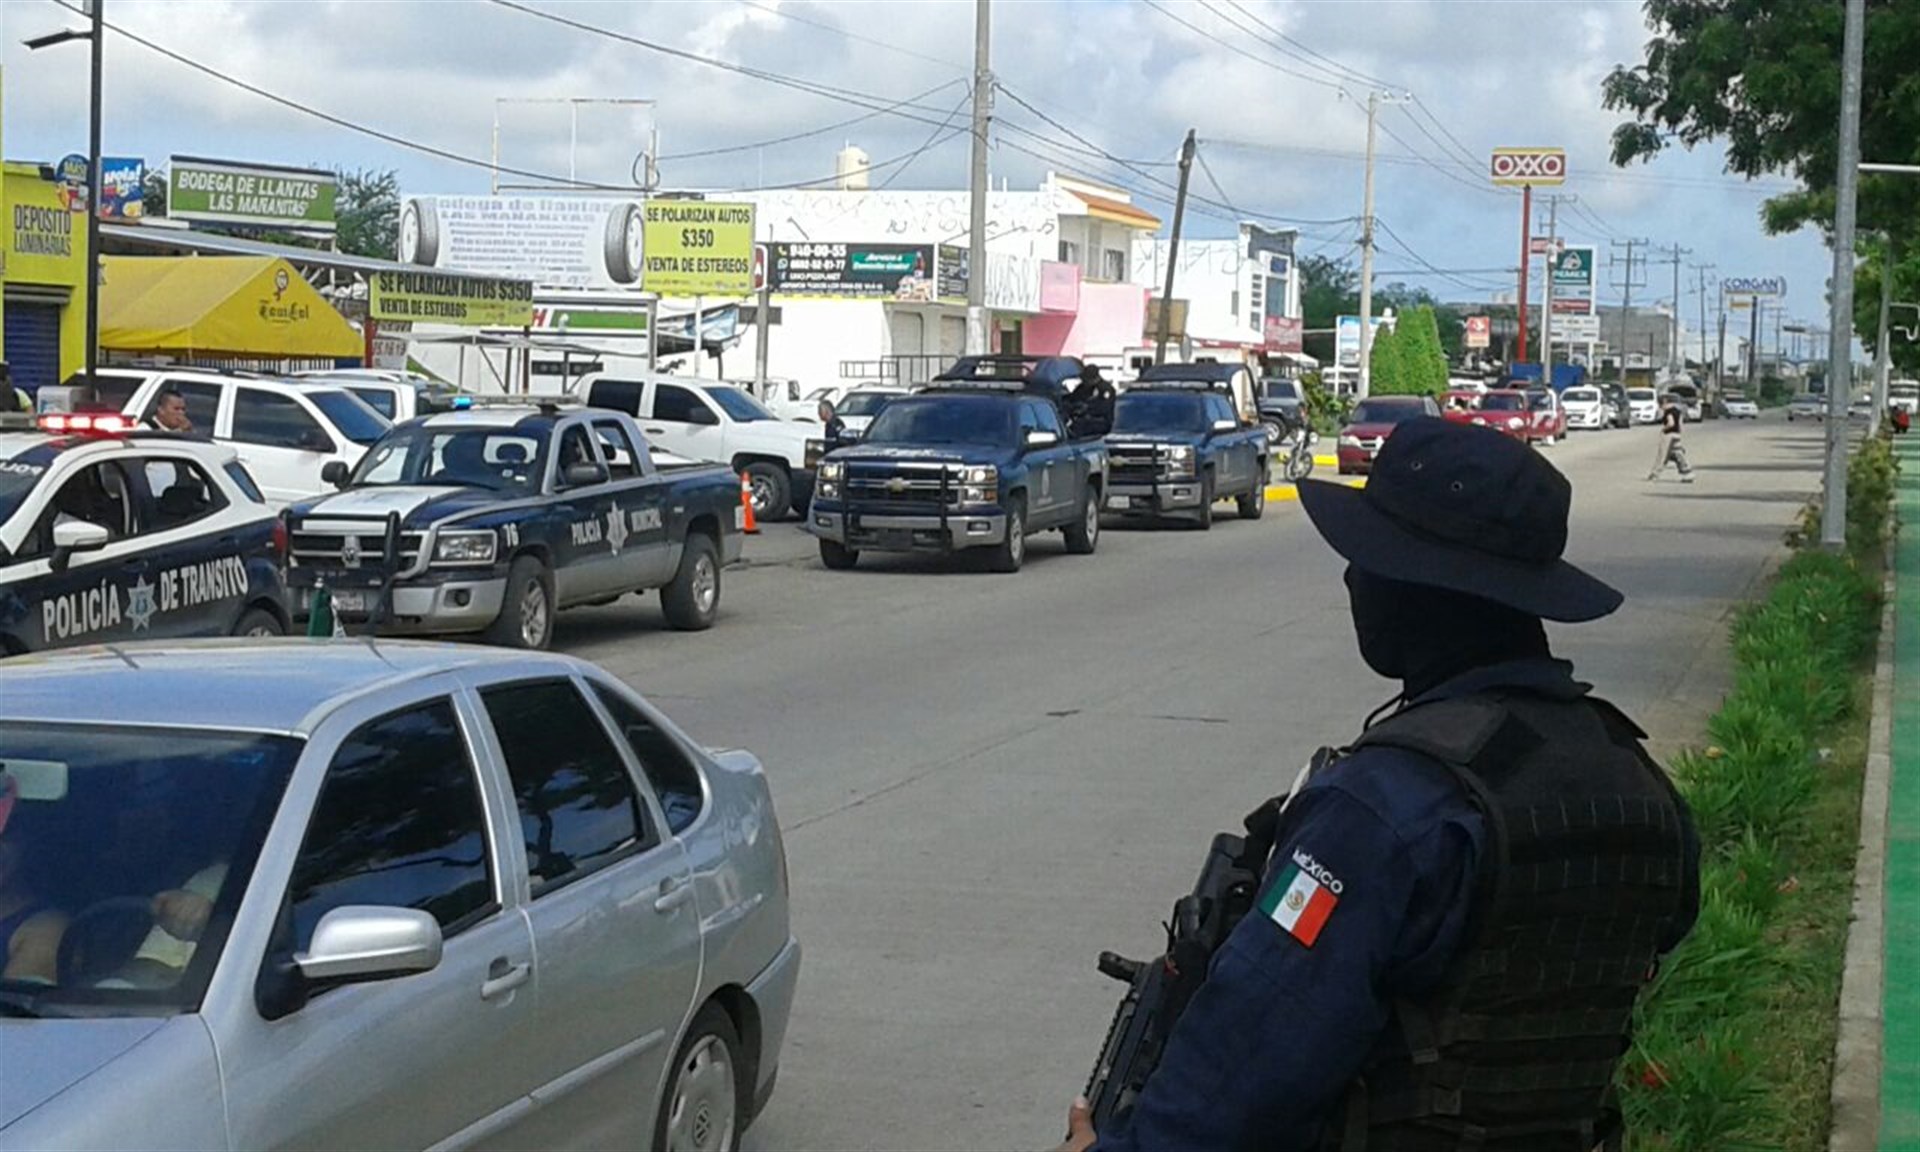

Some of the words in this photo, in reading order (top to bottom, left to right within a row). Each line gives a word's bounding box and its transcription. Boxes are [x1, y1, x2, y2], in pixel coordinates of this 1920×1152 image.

[1494, 154, 1562, 176] OXXO
[178, 171, 234, 193] BODEGA
[236, 175, 255, 194] DE
[258, 178, 319, 200] LLANTAS
[208, 194, 233, 212] LAS
[646, 207, 660, 222] SE
[661, 207, 716, 223] POLARIZAN
[717, 208, 750, 224] AUTOS
[14, 204, 71, 235] DEPOSITO
[681, 228, 714, 248] $350
[646, 256, 679, 272] VENTA
[681, 257, 695, 272] DE
[696, 257, 749, 274] ESTEREOS
[379, 271, 394, 293] SE
[397, 273, 460, 298] POLARIZAN
[461, 276, 497, 300] AUTOS
[498, 279, 533, 302] $350
[379, 297, 409, 314] VENTA
[411, 298, 423, 315] DE
[424, 300, 468, 318] ESTEREOS
[571, 512, 602, 546] POLICÍA
[42, 577, 121, 643] POLICÍA
[160, 569, 178, 612] DE
[181, 555, 249, 607] TRANSITO
[1292, 848, 1344, 894] MÉXICO
